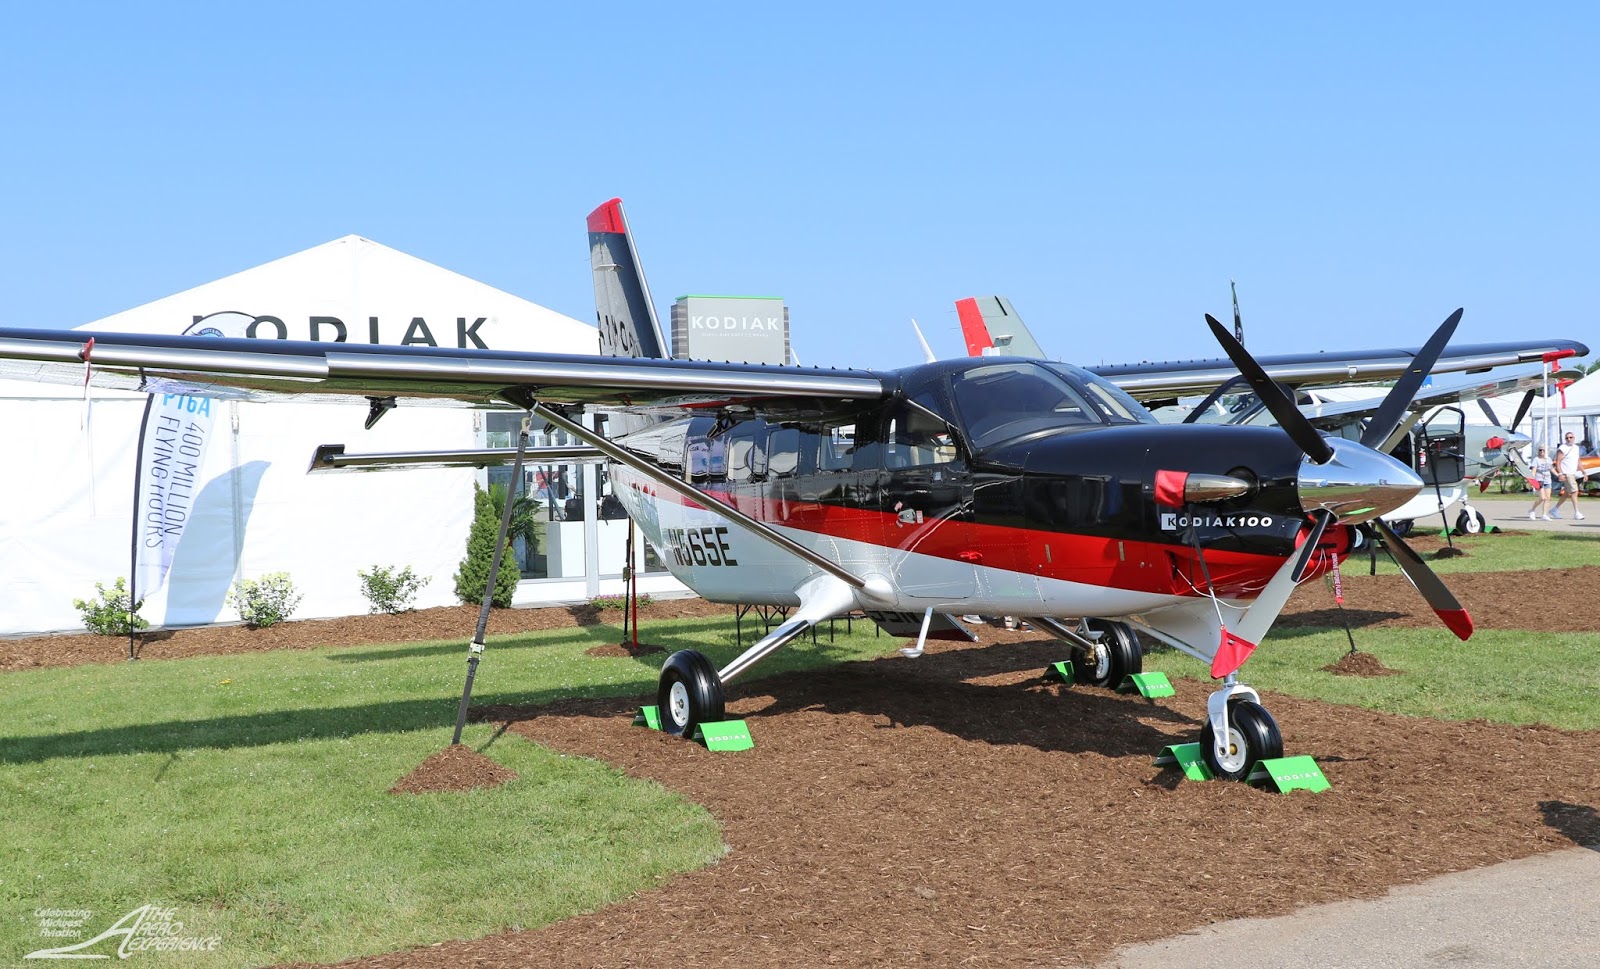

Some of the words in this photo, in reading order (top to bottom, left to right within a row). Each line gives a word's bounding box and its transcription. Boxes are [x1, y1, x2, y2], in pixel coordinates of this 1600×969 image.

[193, 315, 489, 350] ODIAK
[692, 315, 779, 331] KODIAK
[151, 415, 181, 480] FLYING
[179, 422, 205, 459] 400
[145, 484, 165, 549] HOURS
[164, 460, 197, 536] MILLION
[667, 526, 738, 567] N565E
[708, 734, 747, 742] KODIAK
[1277, 771, 1319, 782] KODIAK
